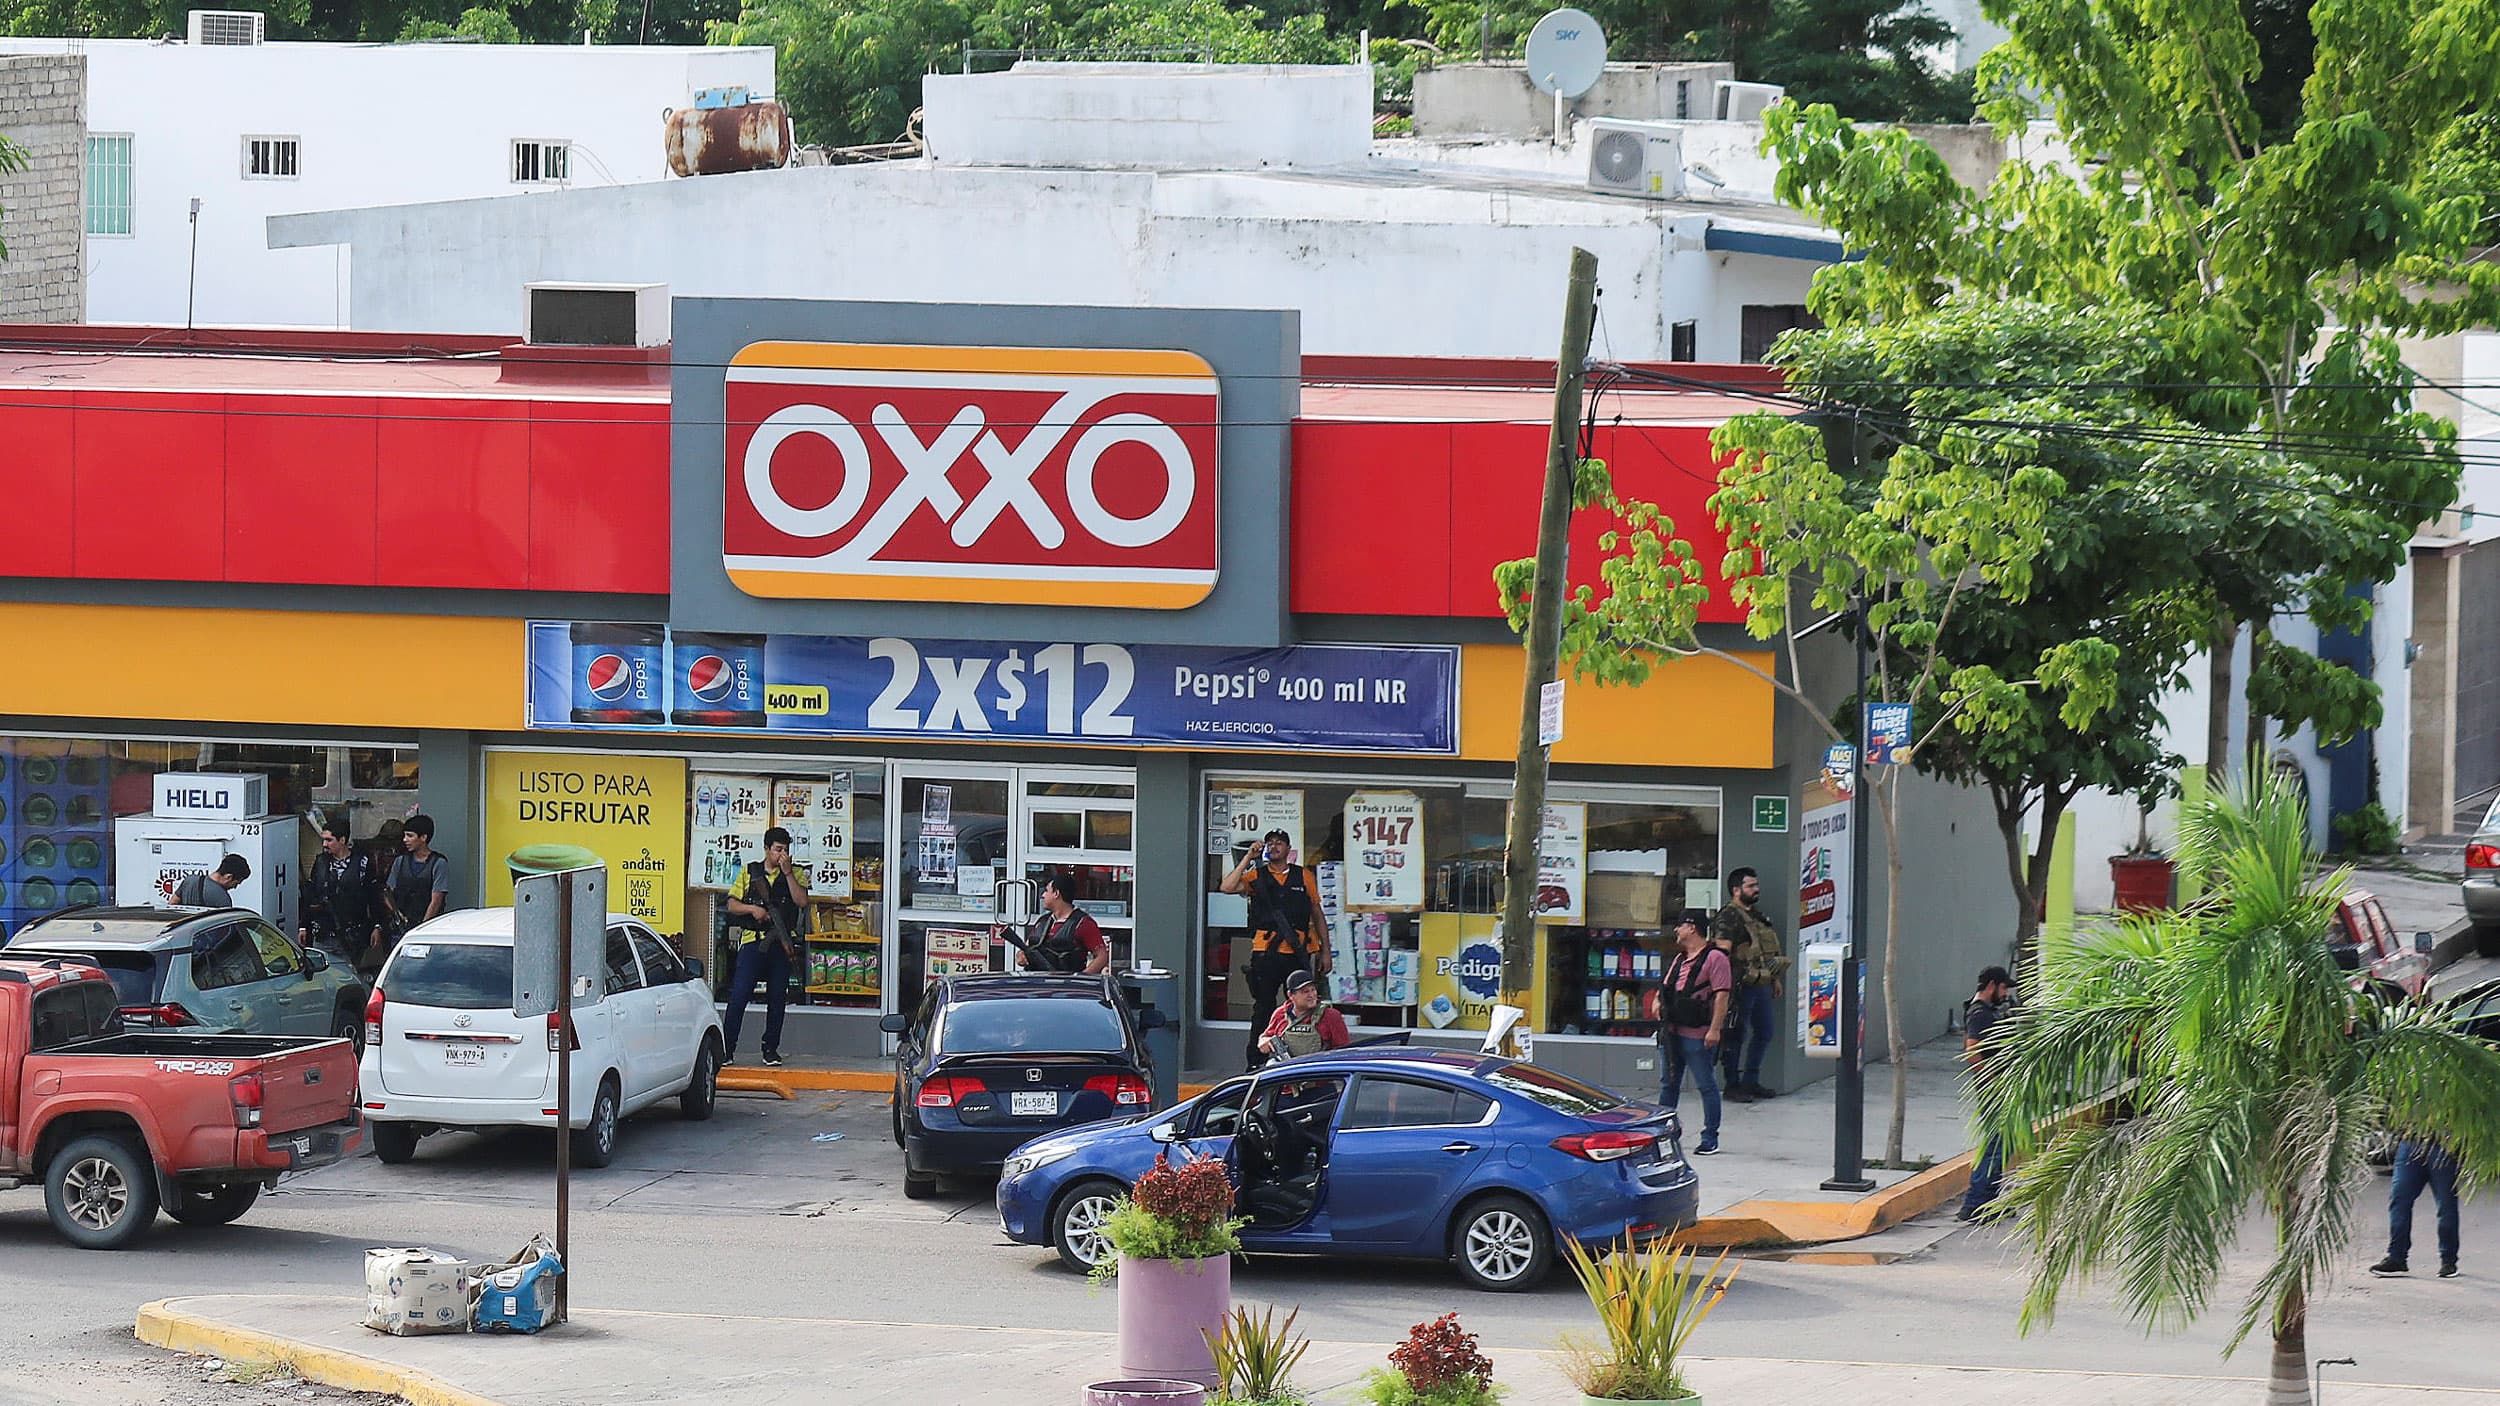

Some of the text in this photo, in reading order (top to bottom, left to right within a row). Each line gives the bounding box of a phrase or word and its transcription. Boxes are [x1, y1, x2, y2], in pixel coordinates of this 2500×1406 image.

[1555, 30, 1582, 41] SKY
[743, 392, 1197, 561] OXXO
[633, 657, 649, 700] pepsi
[734, 658, 751, 701] pepsi
[1277, 677, 1324, 701] 400
[1333, 678, 1364, 703] ml
[1374, 679, 1406, 704] NR
[767, 694, 822, 709] 400 ml
[1185, 720, 1210, 732] HAZ
[1212, 721, 1277, 735] EJERCICIO.
[519, 771, 652, 797] LISTO PARA
[166, 789, 229, 809] HIELO
[822, 796, 843, 810] $36
[519, 800, 651, 826] DISFRUTAR
[240, 823, 260, 836] 723
[1231, 813, 1259, 831] $10
[1353, 816, 1415, 846] $147
[822, 834, 843, 848] $10
[622, 858, 665, 871] andatti
[1365, 883, 1372, 893] y
[630, 898, 646, 907] UN
[630, 905, 657, 917] CAFÉ
[1435, 956, 1501, 981] Pedigr
[154, 1060, 196, 1073] TRD
